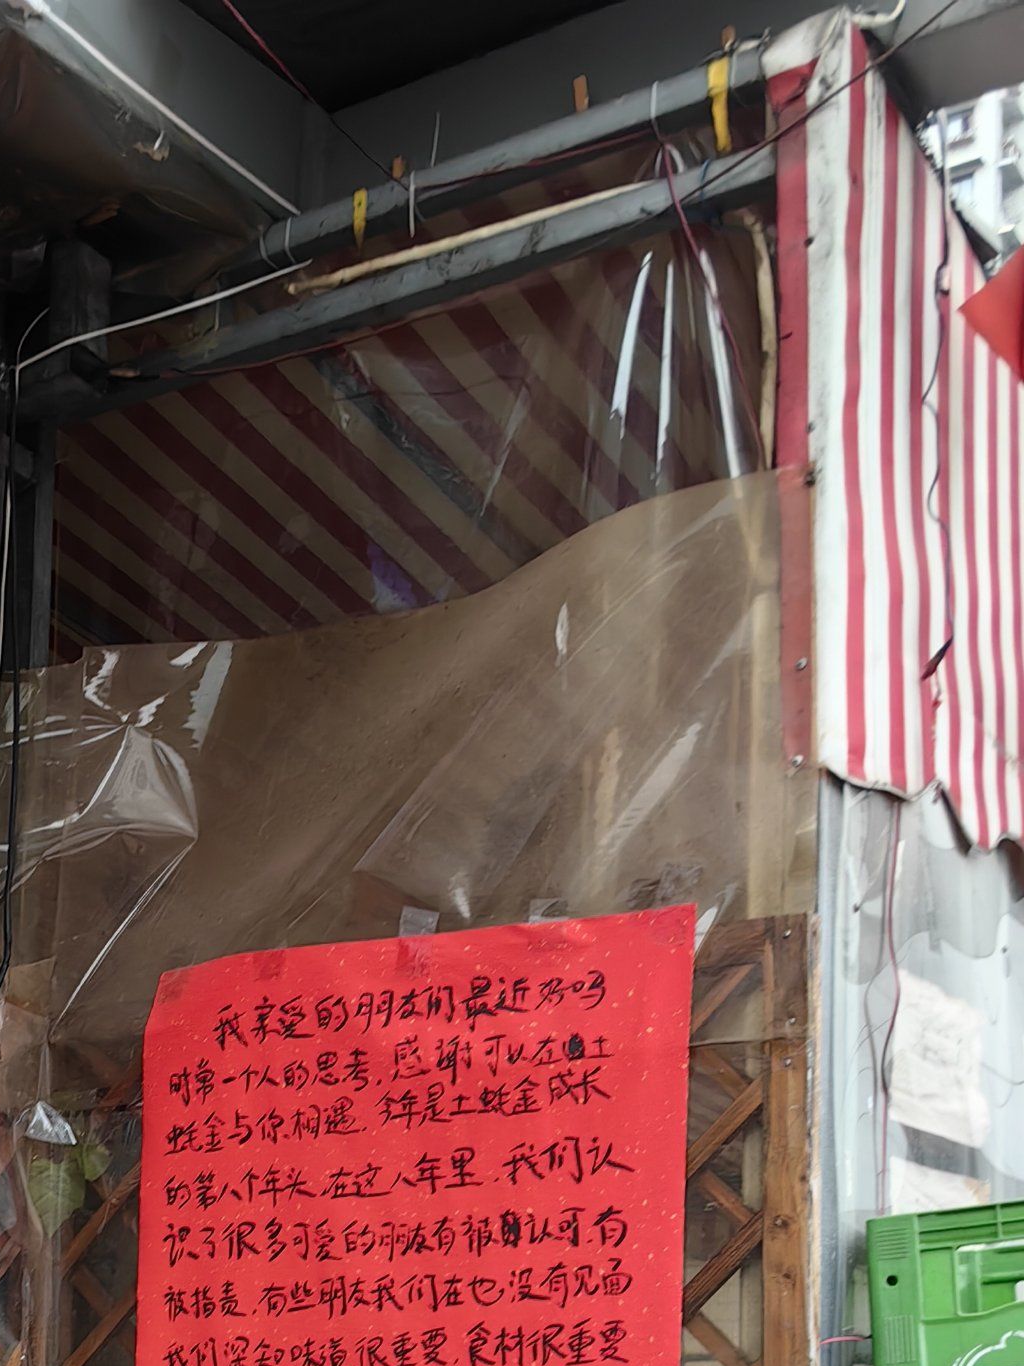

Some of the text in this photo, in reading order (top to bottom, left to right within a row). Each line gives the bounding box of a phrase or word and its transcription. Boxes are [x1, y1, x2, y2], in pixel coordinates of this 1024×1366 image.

[212, 970, 606, 1050] 我亲爱的朋友们最近好吗
